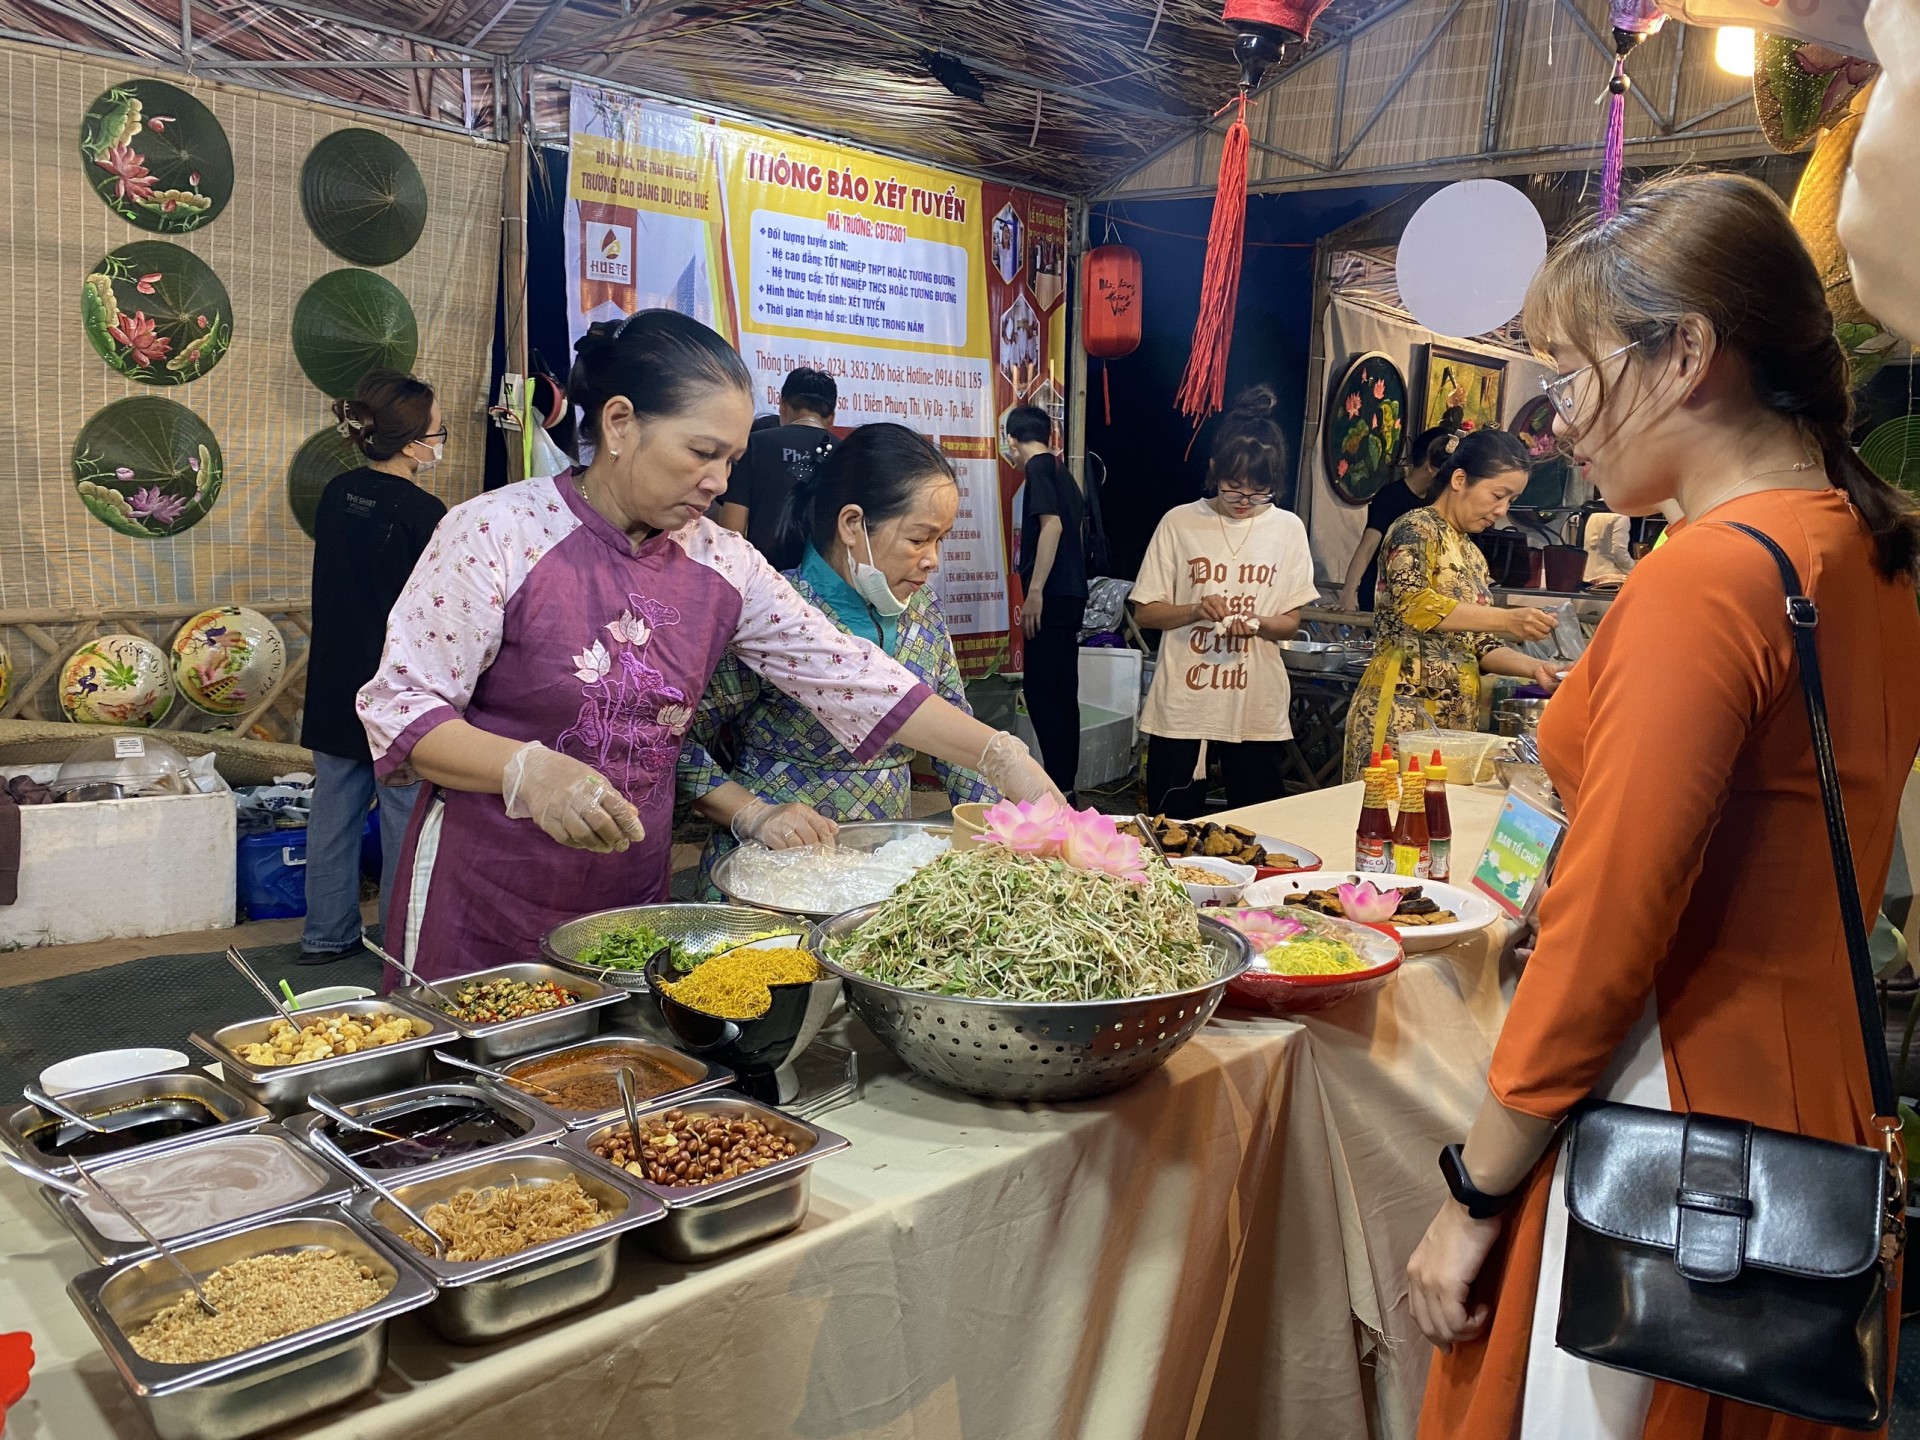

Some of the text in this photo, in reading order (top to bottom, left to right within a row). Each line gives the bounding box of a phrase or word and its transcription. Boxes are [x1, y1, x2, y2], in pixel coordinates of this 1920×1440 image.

[581, 171, 709, 210] TRƯỜNG CAO ĐẲNG DU LỊCH HUẾ
[748, 152, 966, 223] THÔNG BÁO XÉT TUYỂN
[768, 227, 780, 240] Đối
[783, 230, 806, 246] tượng
[830, 239, 848, 252] sinh:
[827, 209, 906, 243] MÃ TRƯỜNG: CĐT3301
[772, 247, 955, 287] Hệ cao đẳng: TỐT NGHIỆP THPT HOẶC TƯƠNG ĐƯƠNG
[766, 284, 784, 297] Hình
[787, 287, 804, 299] thức
[829, 295, 847, 305] sinh:
[848, 295, 861, 308] XÉT
[772, 266, 782, 280] Hệ
[785, 268, 806, 283] trung
[808, 270, 823, 286] cấp:
[826, 272, 838, 286] TỐT
[841, 277, 866, 292] NGHIỆP
[869, 282, 886, 294] THCS
[889, 284, 908, 298] HOẶC
[911, 288, 933, 301] TƯƠNG
[766, 303, 783, 315] Thời
[786, 306, 804, 318] gian
[806, 308, 822, 321] nhận
[836, 313, 847, 324] sơ:
[849, 313, 864, 326] LIÊN
[867, 317, 880, 329] TỤC
[882, 318, 905, 331] TRONG
[907, 319, 924, 333] NĂM
[756, 350, 781, 376] Thông
[784, 354, 795, 371] tin
[827, 358, 848, 377] 0234.
[851, 360, 868, 380] 3826
[871, 363, 885, 381] 206
[887, 364, 904, 387] hoặc
[907, 366, 933, 386] Hotline:
[935, 369, 952, 387] 0914
[955, 370, 966, 387] 611
[968, 372, 982, 389] 185
[838, 398, 848, 410] sơ:
[853, 393, 861, 411] 01
[885, 396, 907, 418] Phùng
[934, 399, 942, 420] Dạ
[949, 400, 959, 421] Tp.
[961, 400, 974, 419] Huế
[1187, 556, 1278, 588] Do not
[1200, 590, 1258, 616] iss
[1186, 662, 1248, 690] Club
[1496, 832, 1512, 848] BAN
